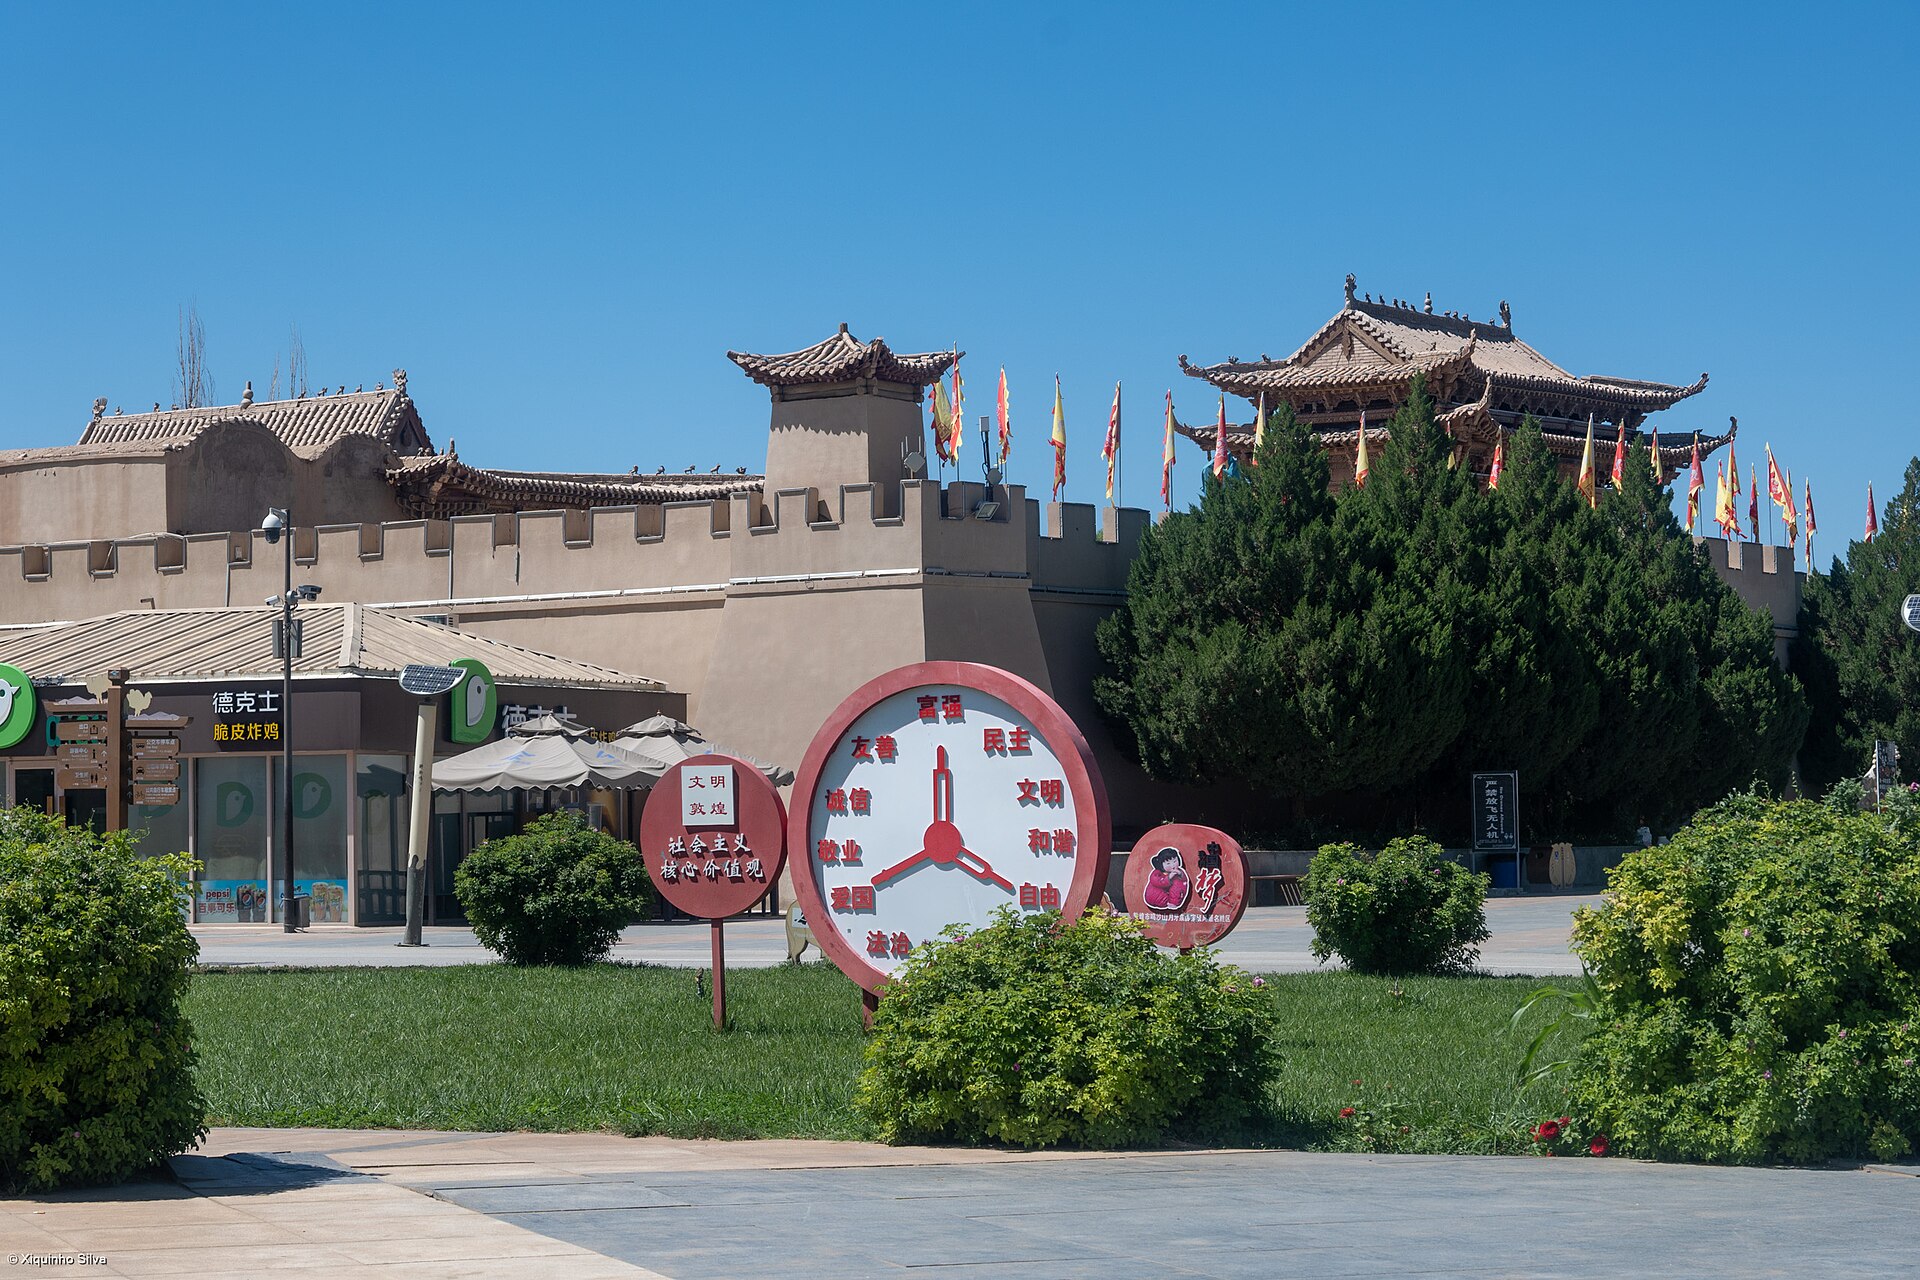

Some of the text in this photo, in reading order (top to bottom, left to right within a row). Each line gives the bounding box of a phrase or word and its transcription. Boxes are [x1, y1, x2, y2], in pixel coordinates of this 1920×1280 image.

[212, 690, 279, 713] 德克士
[917, 695, 963, 719] 富强
[213, 722, 279, 741] 脆皮炸鸡
[983, 726, 1031, 752] 民主
[851, 735, 896, 759] 友善
[688, 775, 726, 789] 文明
[1016, 778, 1062, 804] 文明
[688, 801, 728, 816] 敦煌
[825, 788, 869, 812] 诚信
[1485, 780, 1499, 839] 严禁放飞无人机
[668, 833, 752, 854] 社会主义
[818, 839, 861, 863] 敬业
[1027, 827, 1073, 854] 和谐
[660, 858, 764, 879] 核心价值观
[205, 888, 230, 900] pepsi
[831, 885, 874, 910] 爱国
[1019, 881, 1060, 907] 自由
[199, 902, 235, 914] 百事可乐
[866, 930, 910, 955] 法治
